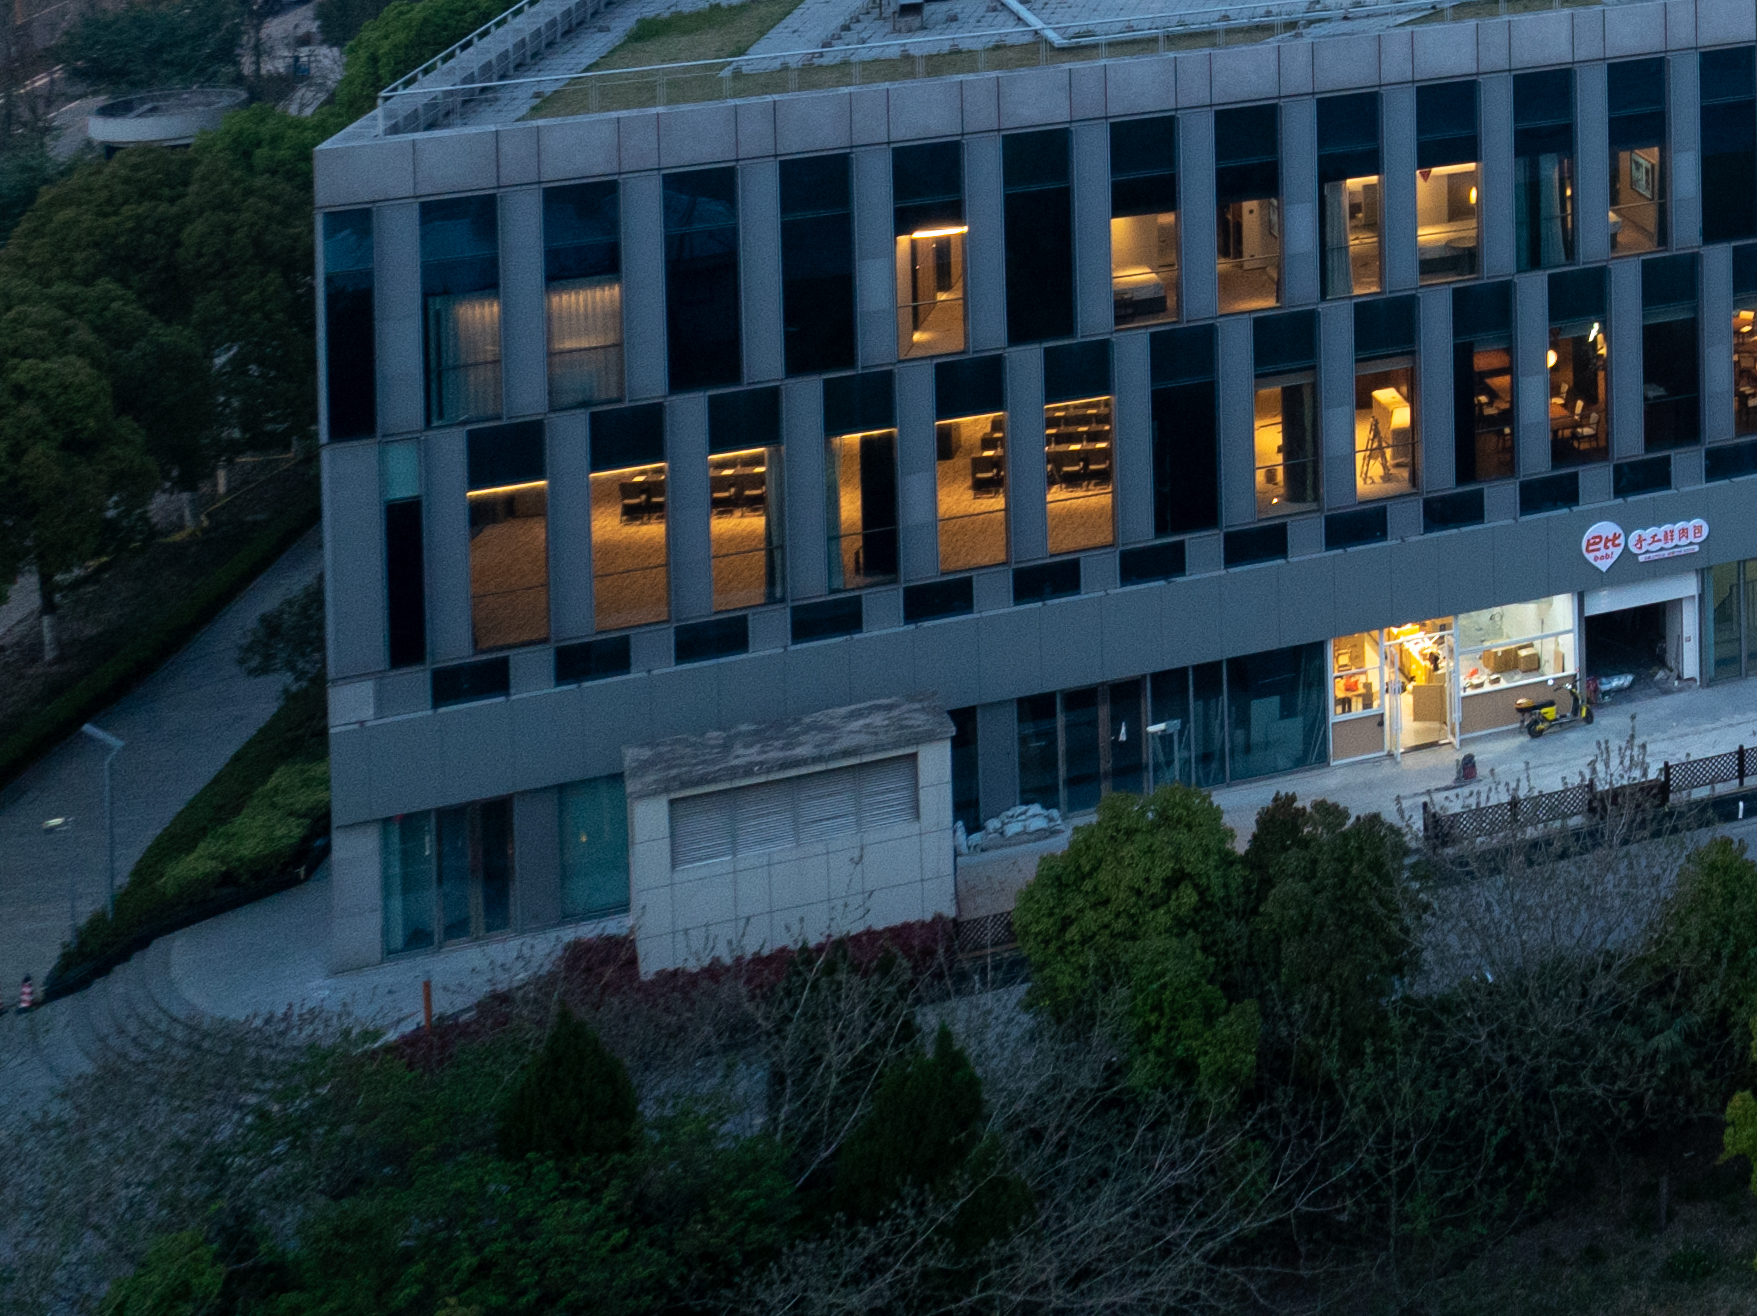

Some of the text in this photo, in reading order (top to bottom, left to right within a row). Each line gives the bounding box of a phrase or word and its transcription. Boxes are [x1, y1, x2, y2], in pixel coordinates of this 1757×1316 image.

[1585, 532, 1622, 554] 巴比
[1634, 524, 1703, 550] 手工鲜肉包
